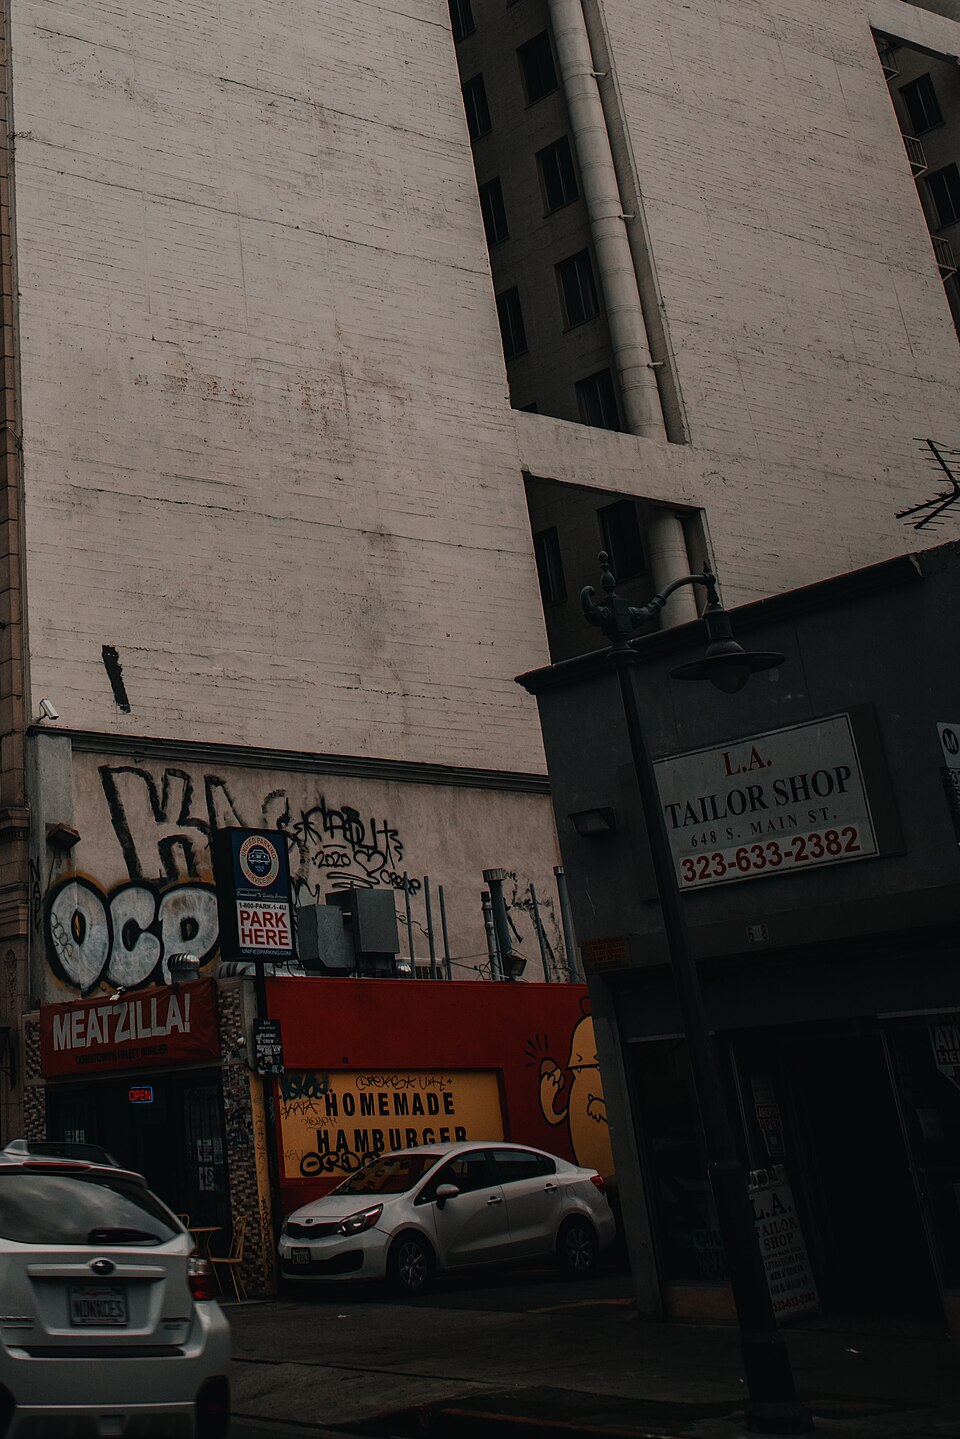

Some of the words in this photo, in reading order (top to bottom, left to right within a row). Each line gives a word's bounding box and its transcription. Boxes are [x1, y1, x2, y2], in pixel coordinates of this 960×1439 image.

[722, 745, 772, 777] L.A.
[665, 785, 769, 830] TAILOR
[772, 765, 851, 807] SHOP
[691, 830, 717, 847] 648
[726, 827, 741, 840] S.
[750, 813, 797, 835] MAIN
[808, 807, 837, 823] ST.
[256, 838, 277, 860] PARKING
[681, 826, 860, 882] 323-633-2382
[239, 910, 288, 929] PARK
[241, 928, 290, 946] HERE
[53, 993, 190, 1052] MEATZILLA!
[128, 1088, 151, 1102] OPEN
[324, 1092, 456, 1117] HOMEMADE
[316, 1126, 468, 1154] HAMBURGER
[751, 1192, 792, 1221] L.A.
[754, 1216, 798, 1239] TAILOR
[763, 1233, 794, 1251] SHOP
